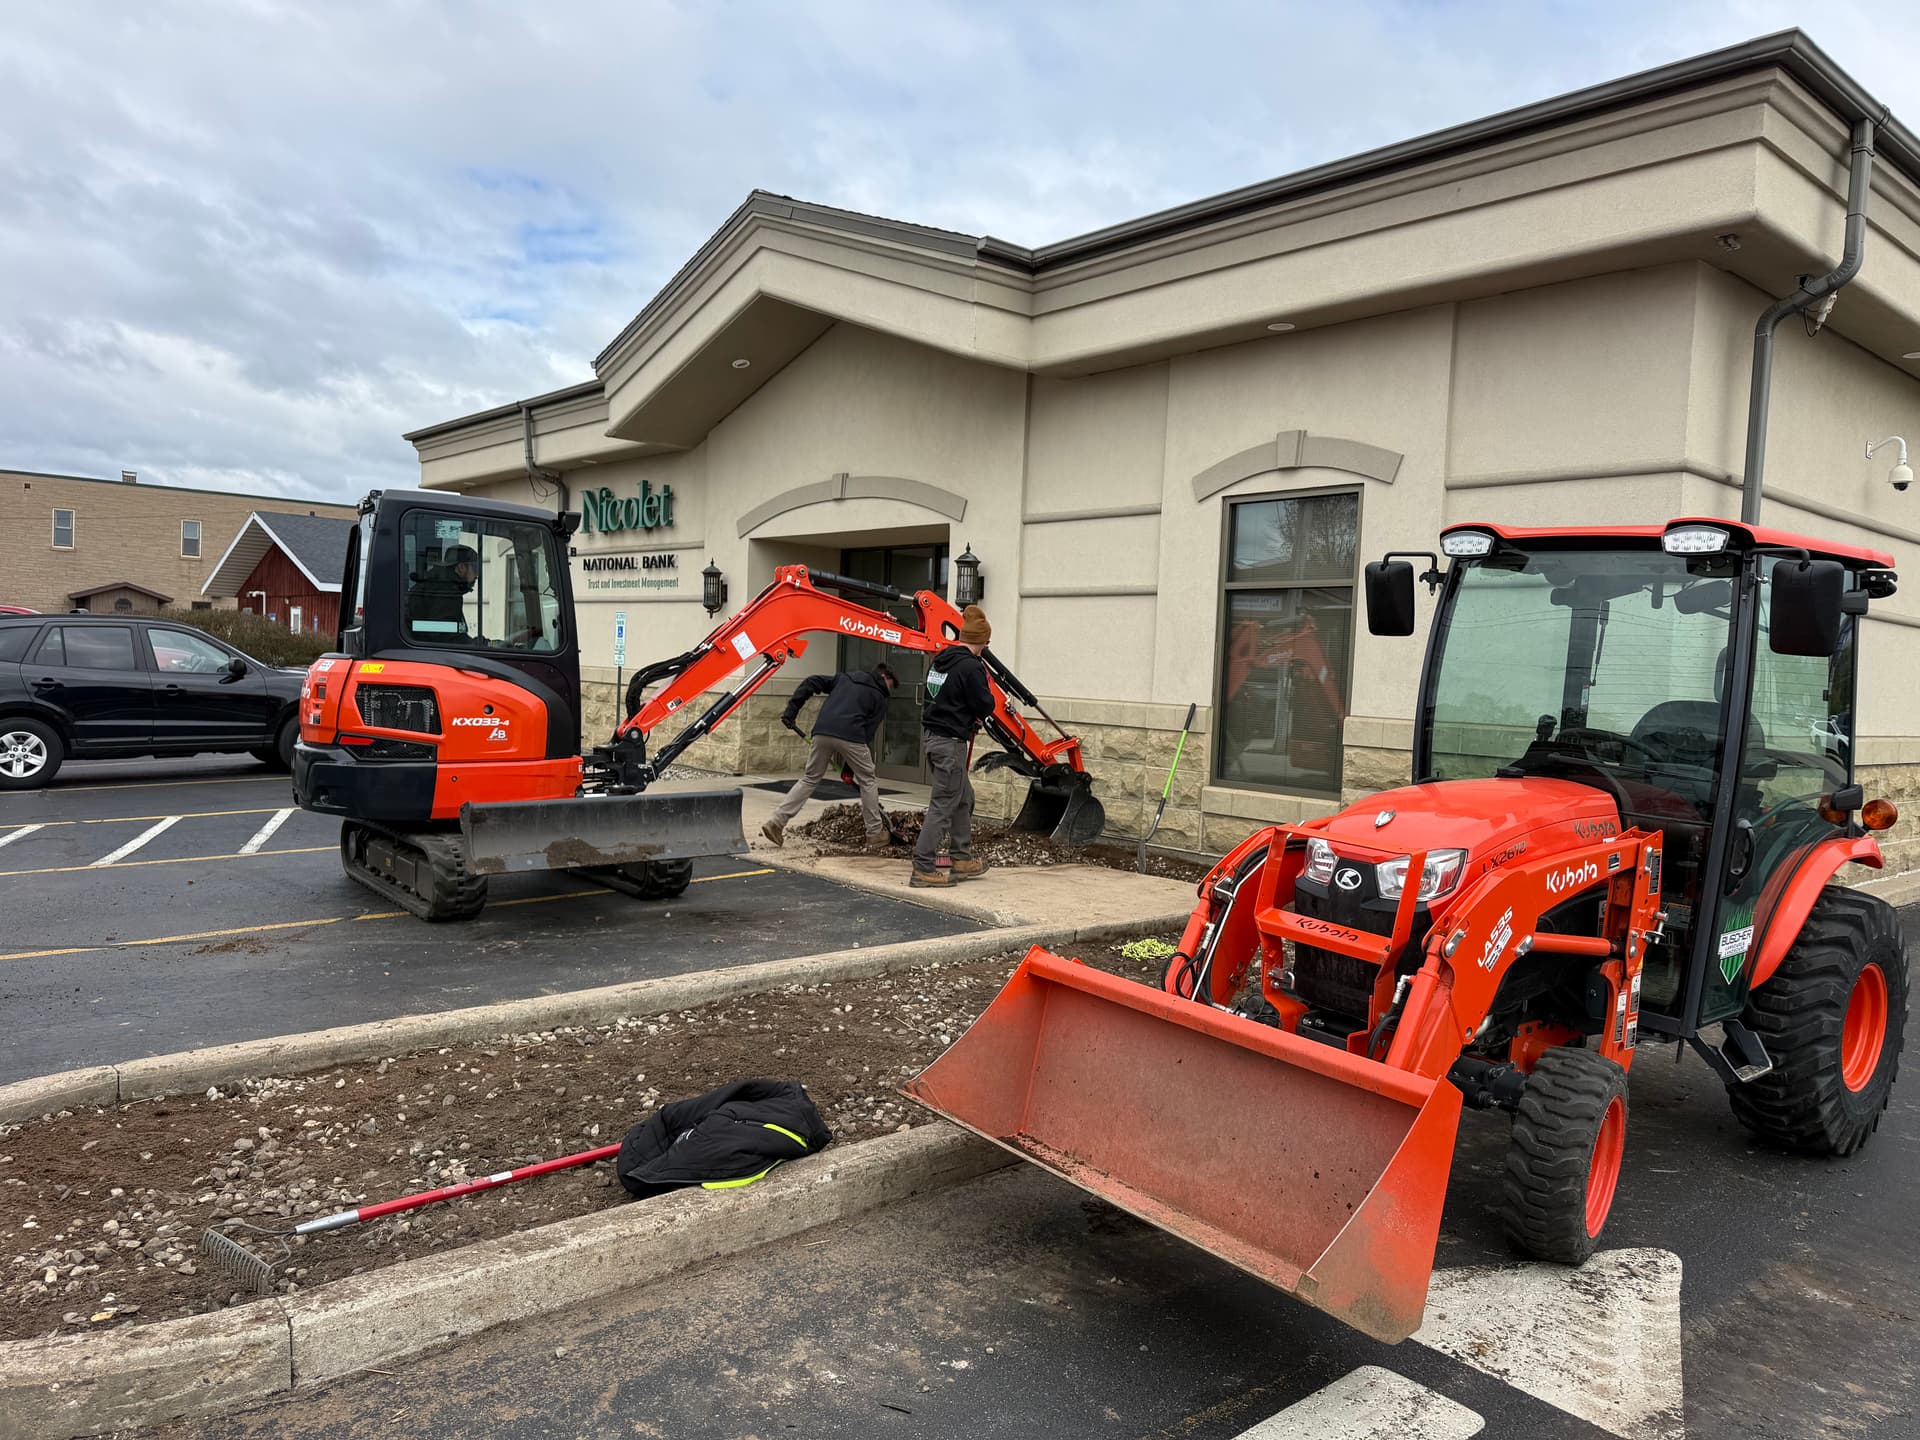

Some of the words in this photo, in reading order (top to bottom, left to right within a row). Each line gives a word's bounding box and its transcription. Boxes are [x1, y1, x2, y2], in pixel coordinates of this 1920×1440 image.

[580, 480, 674, 534] Nicolet
[583, 556, 638, 571] NATIONAL
[642, 554, 676, 569] BANK
[588, 578, 600, 589] Trust
[611, 577, 641, 588] Investment
[641, 576, 679, 590] Management
[839, 615, 885, 638] Kubota
[1573, 817, 1617, 838] Kubota
[1546, 860, 1598, 893] Kubota
[1295, 918, 1359, 942] Kubota
[1477, 905, 1513, 968] LA535
[1721, 929, 1752, 946] BUSCHER
